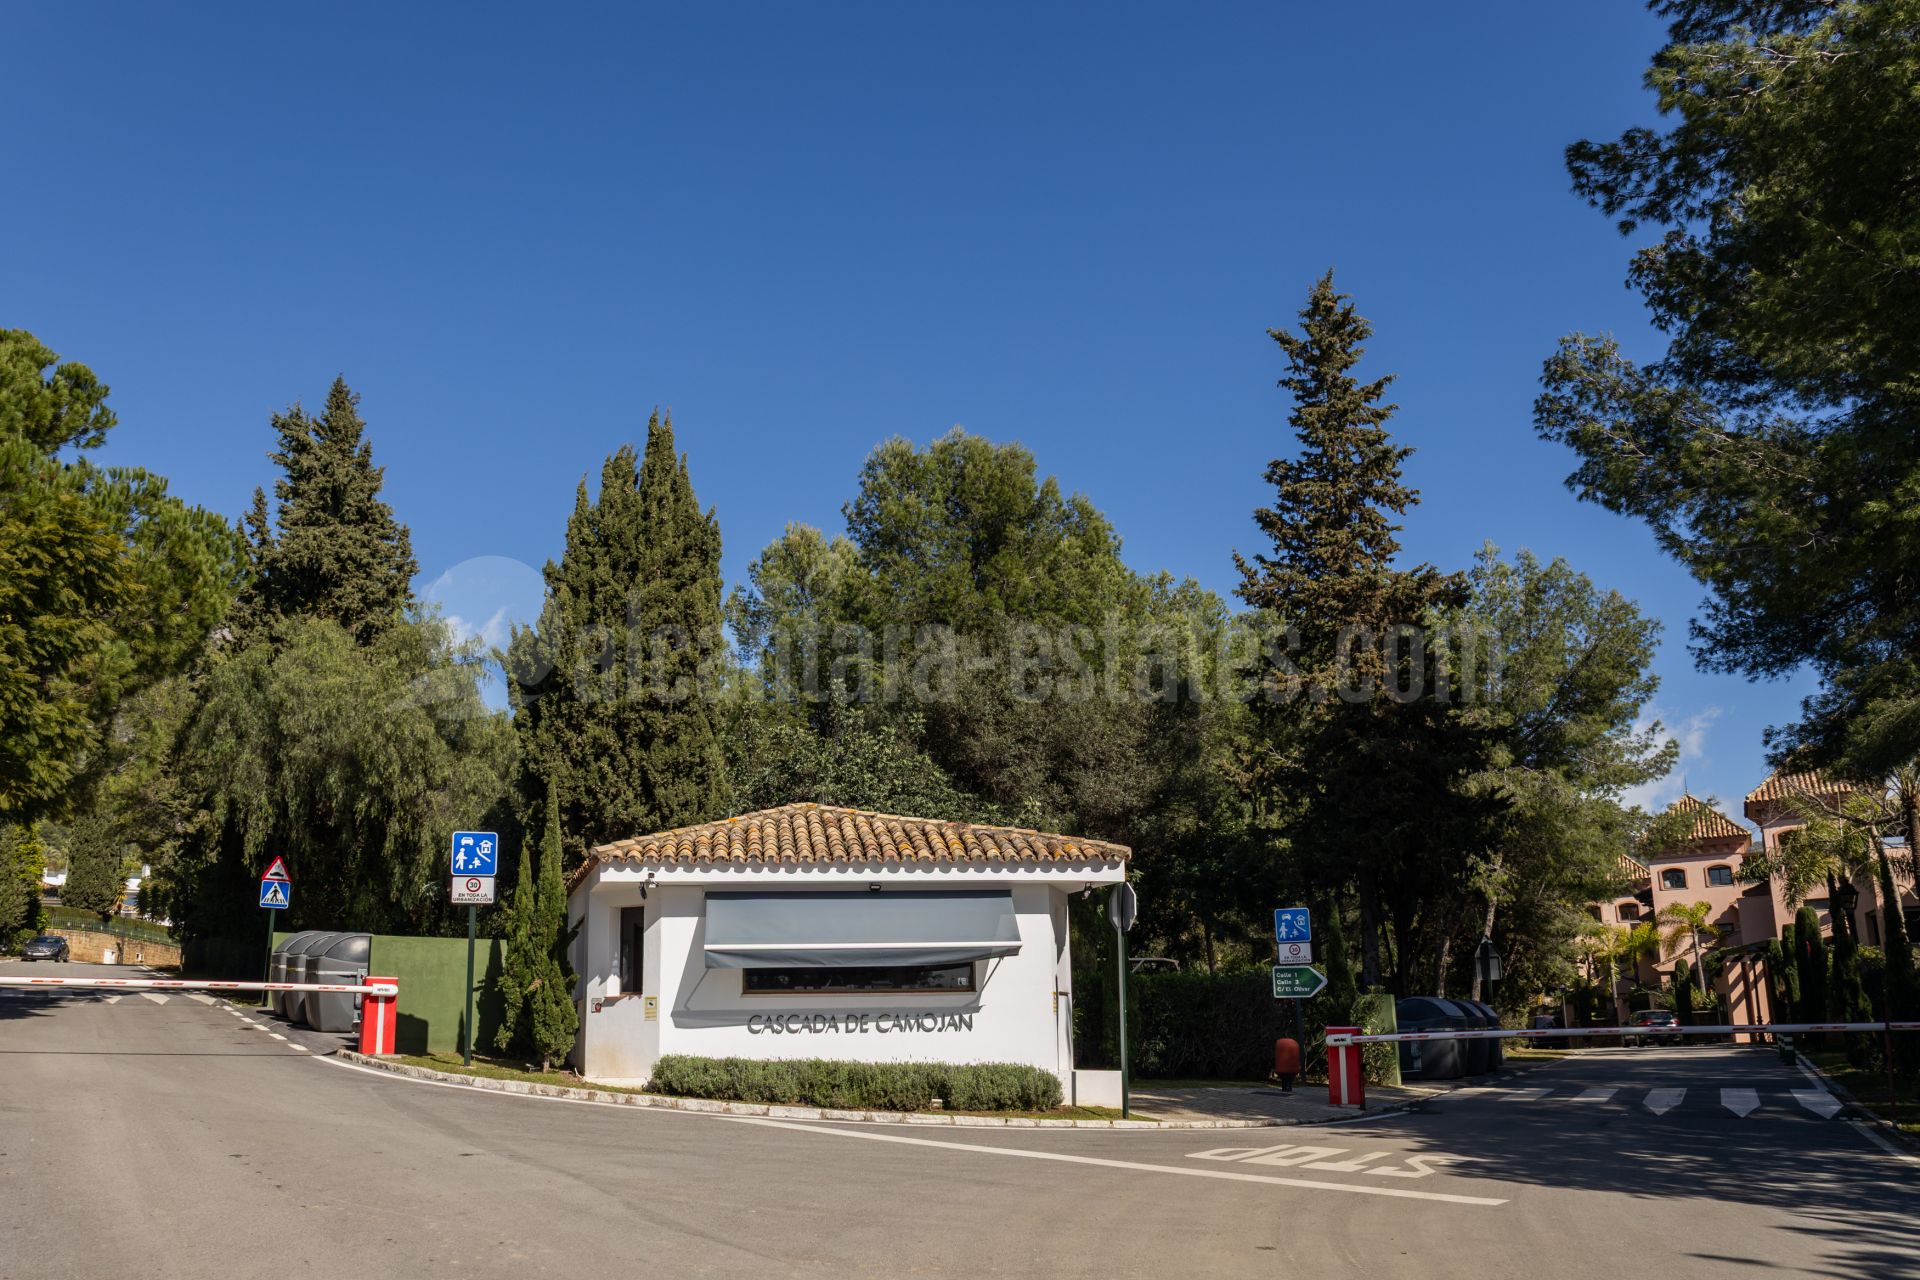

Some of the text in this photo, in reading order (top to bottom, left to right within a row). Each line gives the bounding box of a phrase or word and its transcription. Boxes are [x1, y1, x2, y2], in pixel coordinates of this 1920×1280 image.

[747, 1012, 974, 1034] CASCADA DE CAMOJAN
